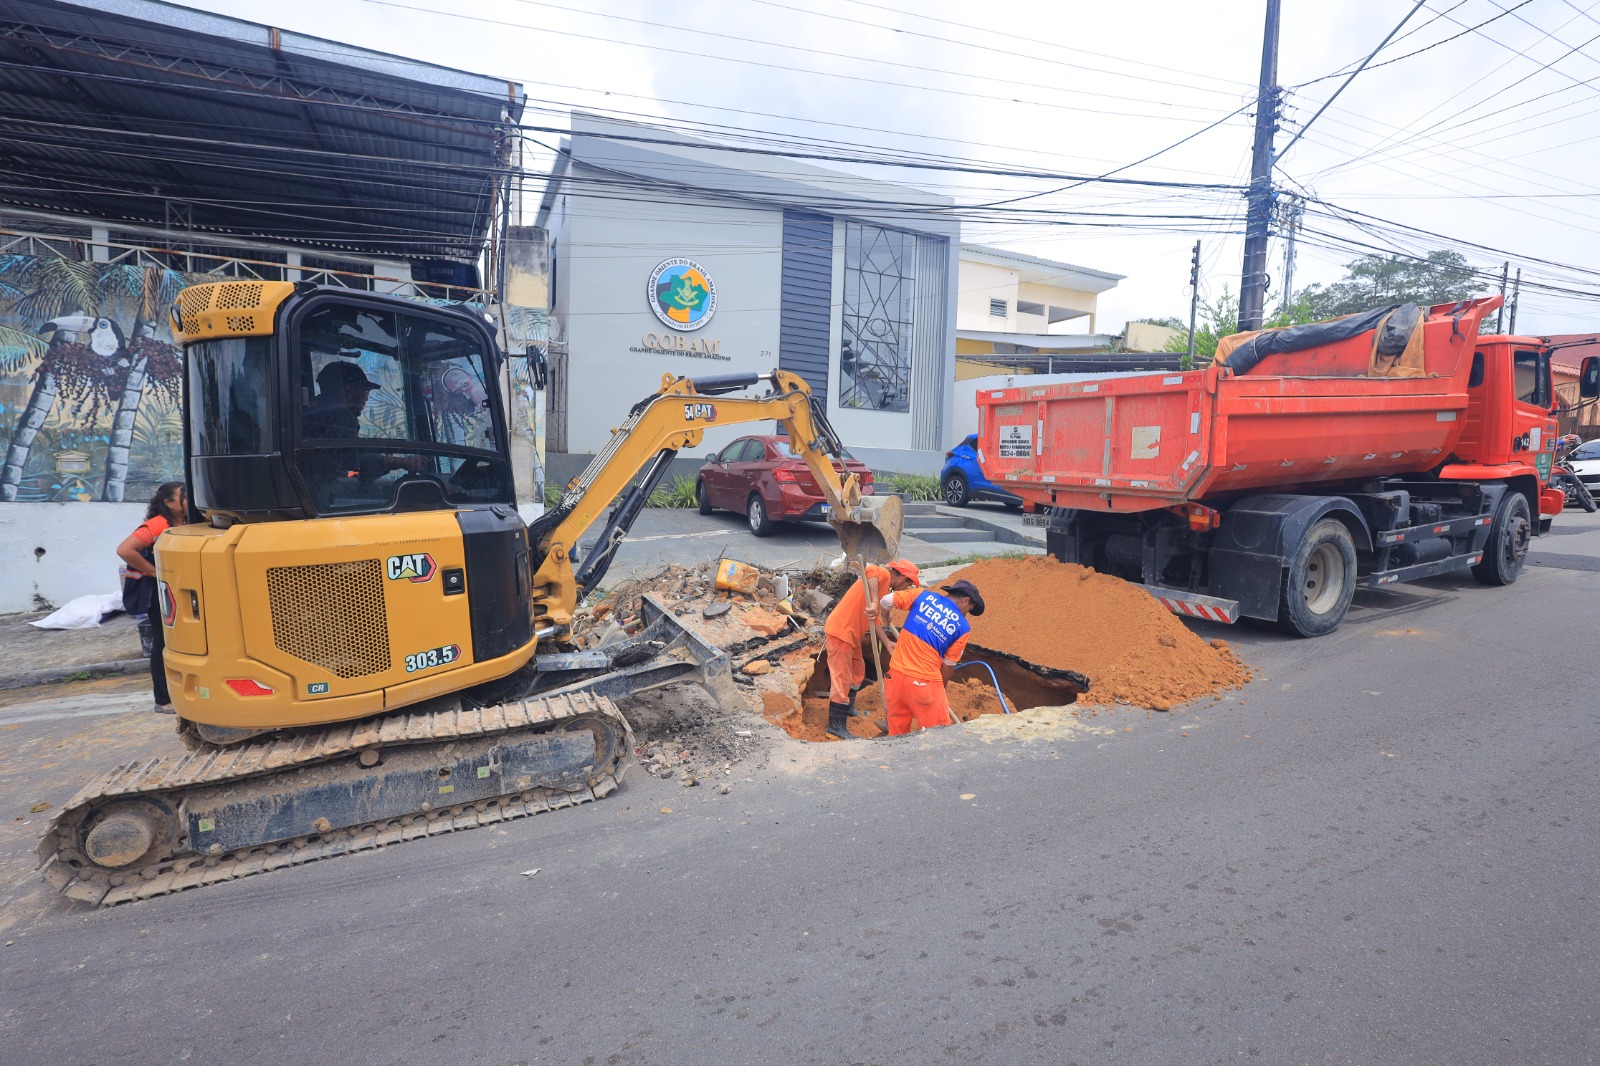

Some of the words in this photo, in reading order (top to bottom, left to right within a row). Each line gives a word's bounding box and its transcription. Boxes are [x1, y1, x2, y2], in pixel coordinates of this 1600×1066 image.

[655, 259, 679, 275] ORIENTE
[689, 261, 708, 279] BRASIL
[707, 278, 716, 313] AMAZONAS
[629, 346, 653, 354] GRANDE
[652, 348, 677, 356] ORIENTE
[685, 351, 703, 359] BRASIL
[703, 353, 731, 361] AMAZONAS
[642, 332, 720, 355] GOBAM
[695, 403, 712, 418] CAT
[387, 554, 425, 580] CAT
[918, 601, 956, 636] VERÃO
[925, 594, 960, 622] PLANO
[405, 645, 453, 673] 303.5
[311, 684, 325, 693] CR
